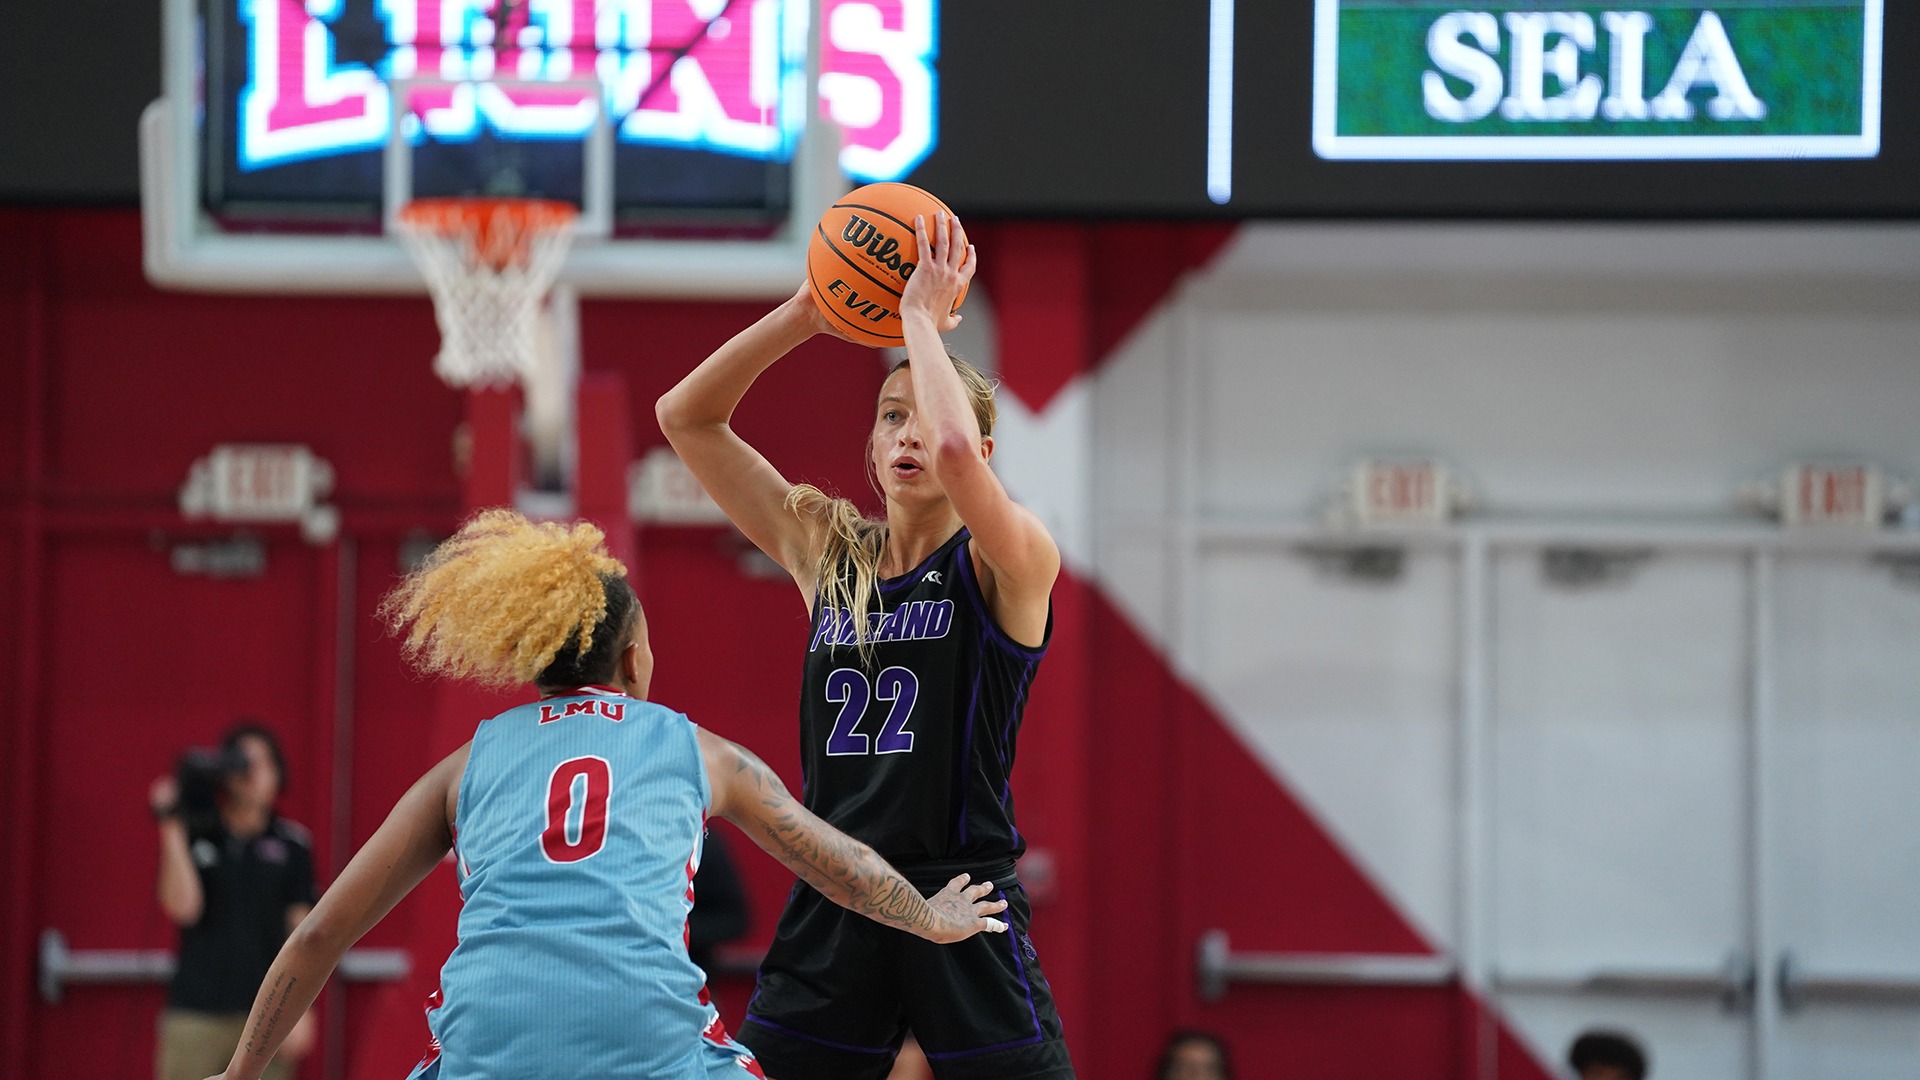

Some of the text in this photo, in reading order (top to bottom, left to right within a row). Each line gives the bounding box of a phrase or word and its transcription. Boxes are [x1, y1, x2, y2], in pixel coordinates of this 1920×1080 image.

[1421, 9, 1767, 122] SEIA
[841, 213, 917, 282] Wilso
[809, 599, 955, 652] PORLAND
[538, 700, 626, 726] LMU
[825, 665, 919, 756] 22
[539, 754, 614, 864] 0
